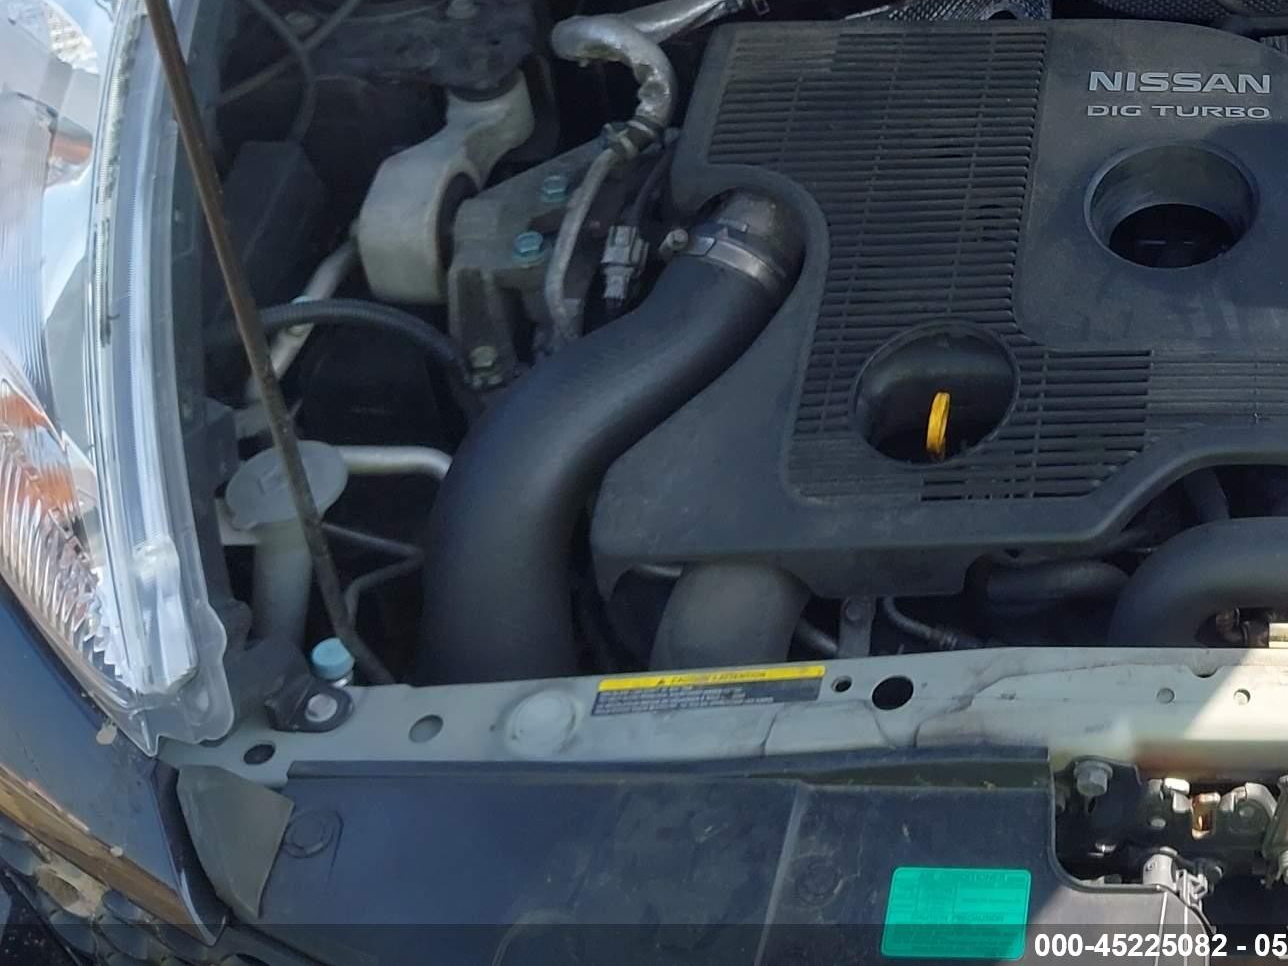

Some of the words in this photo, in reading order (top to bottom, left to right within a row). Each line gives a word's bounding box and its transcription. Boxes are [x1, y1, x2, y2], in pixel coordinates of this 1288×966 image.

[1088, 71, 1271, 94] NISSAN
[1087, 105, 1142, 117] DIG
[1151, 105, 1271, 119] TURBO
